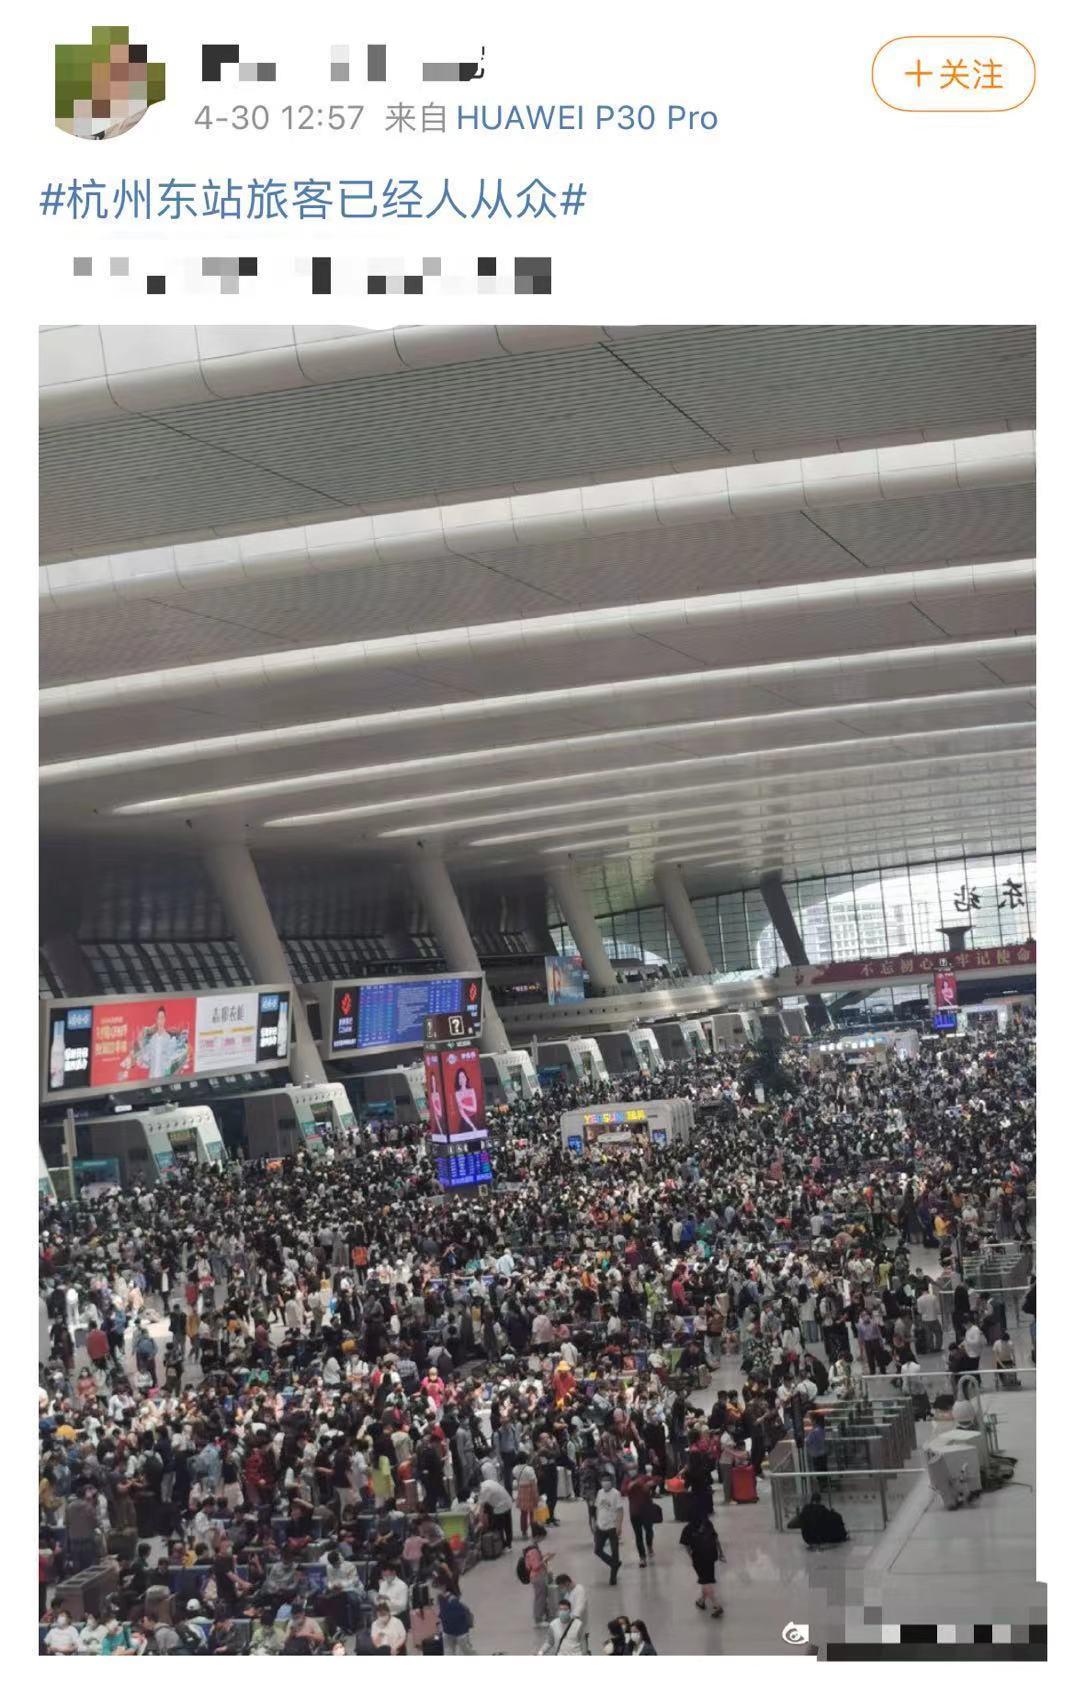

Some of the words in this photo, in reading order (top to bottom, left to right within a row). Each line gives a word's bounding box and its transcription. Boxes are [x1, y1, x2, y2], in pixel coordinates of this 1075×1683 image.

[860, 957, 934, 977] 不忘初心
[956, 947, 1031, 967] 牢记使命
